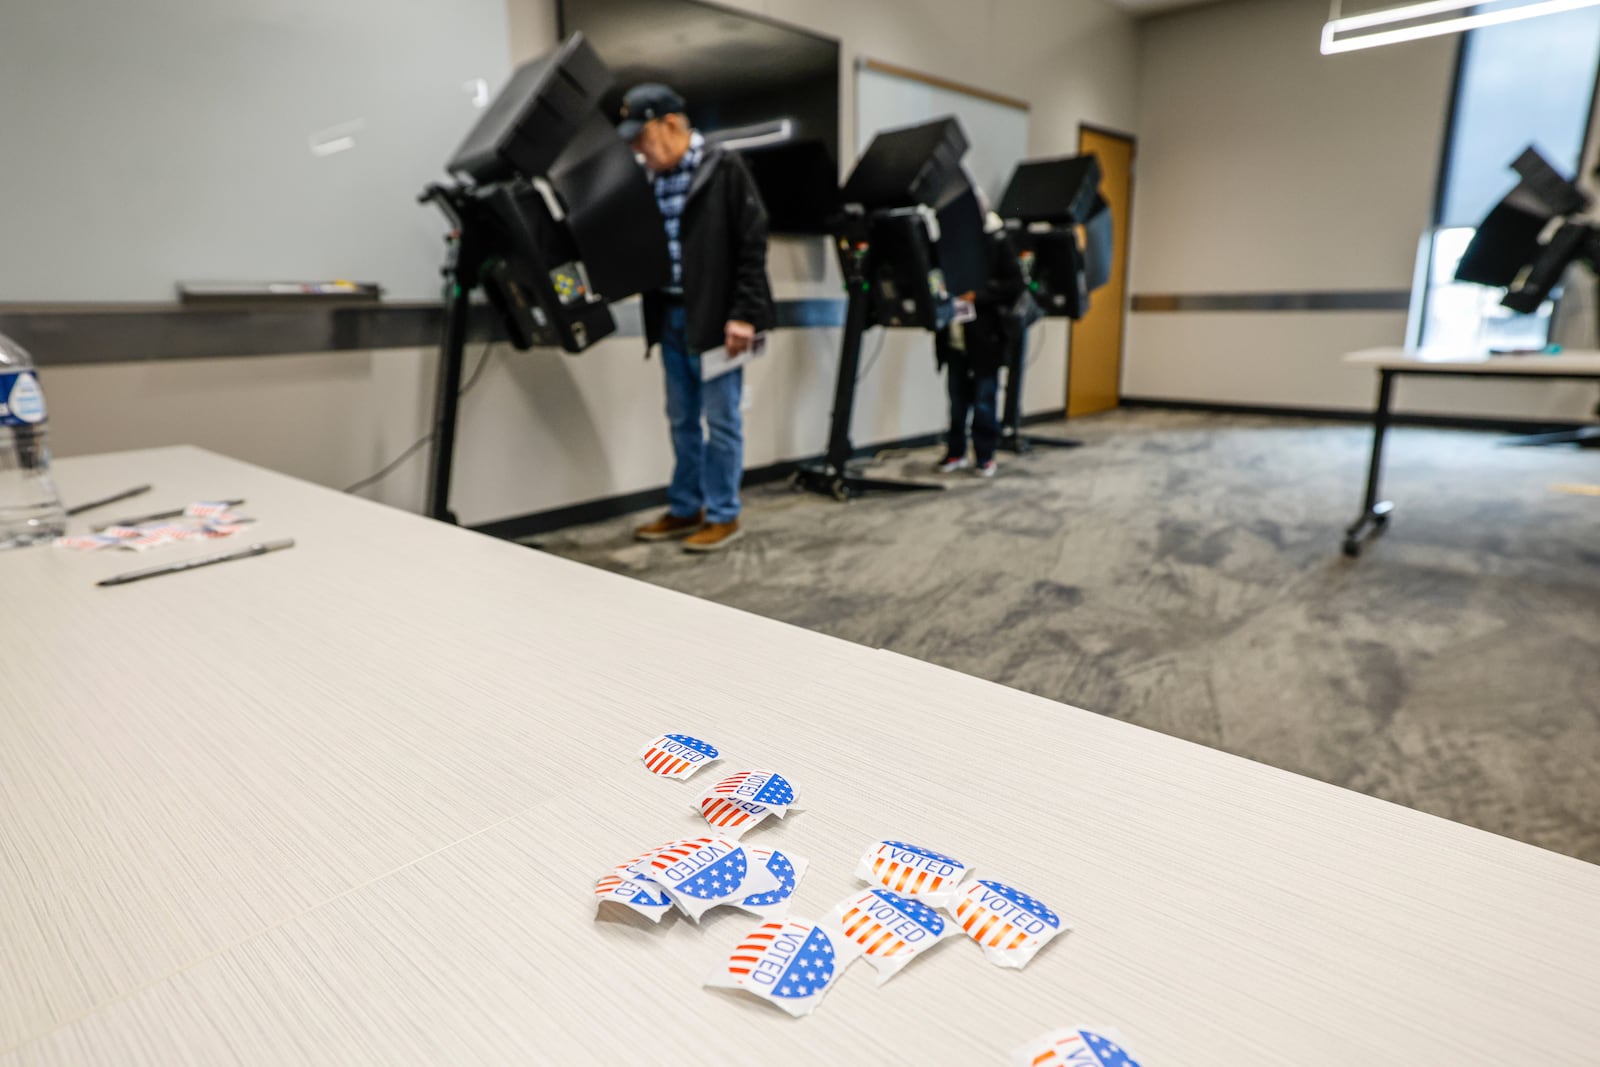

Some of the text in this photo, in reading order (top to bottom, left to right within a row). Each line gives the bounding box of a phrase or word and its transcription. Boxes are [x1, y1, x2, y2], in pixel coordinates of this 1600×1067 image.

[662, 740, 705, 762] VOTED
[665, 846, 726, 881] VOTED
[891, 847, 955, 877] VOTED
[867, 899, 926, 942] VOTED
[980, 890, 1046, 934] VOTED
[752, 933, 805, 986] VOTED
